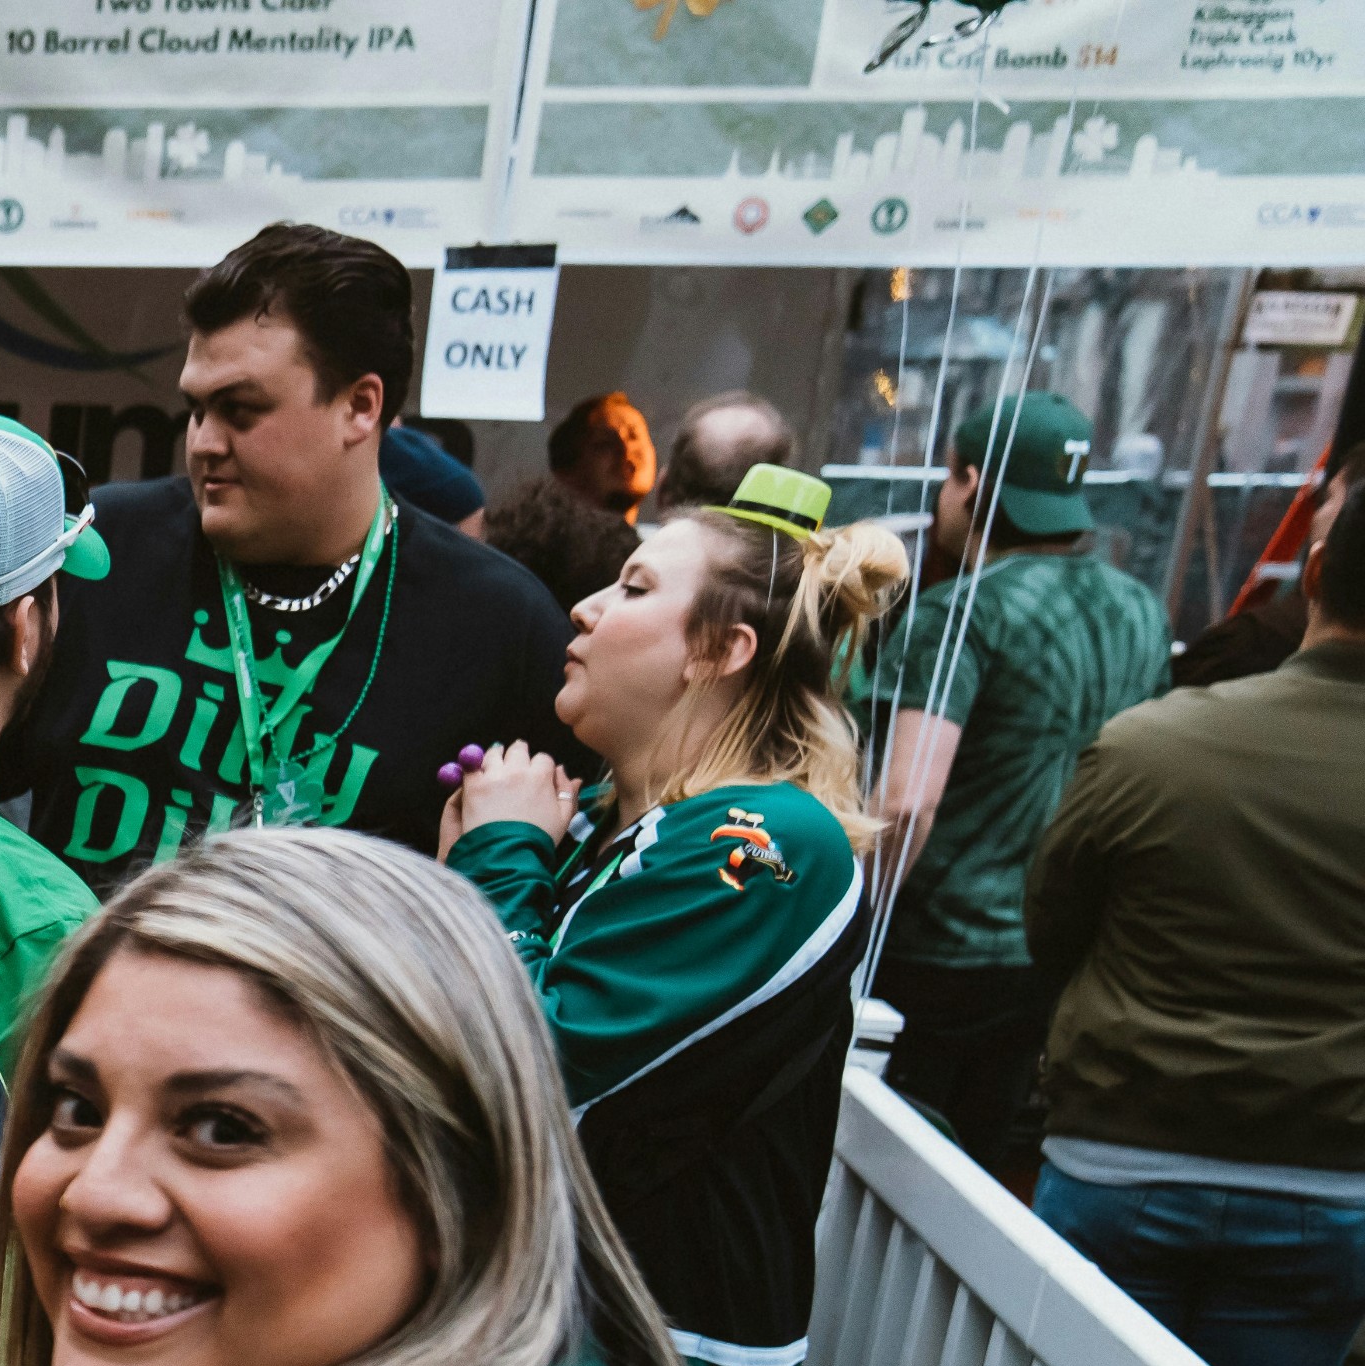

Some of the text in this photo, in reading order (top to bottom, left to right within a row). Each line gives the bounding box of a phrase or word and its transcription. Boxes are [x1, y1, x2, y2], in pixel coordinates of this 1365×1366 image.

[6, 26, 416, 58] 10 Barrel Cloud Mentality IPA
[993, 44, 1068, 70] Bomb
[450, 286, 536, 316] CASH
[443, 341, 528, 370] ONLY
